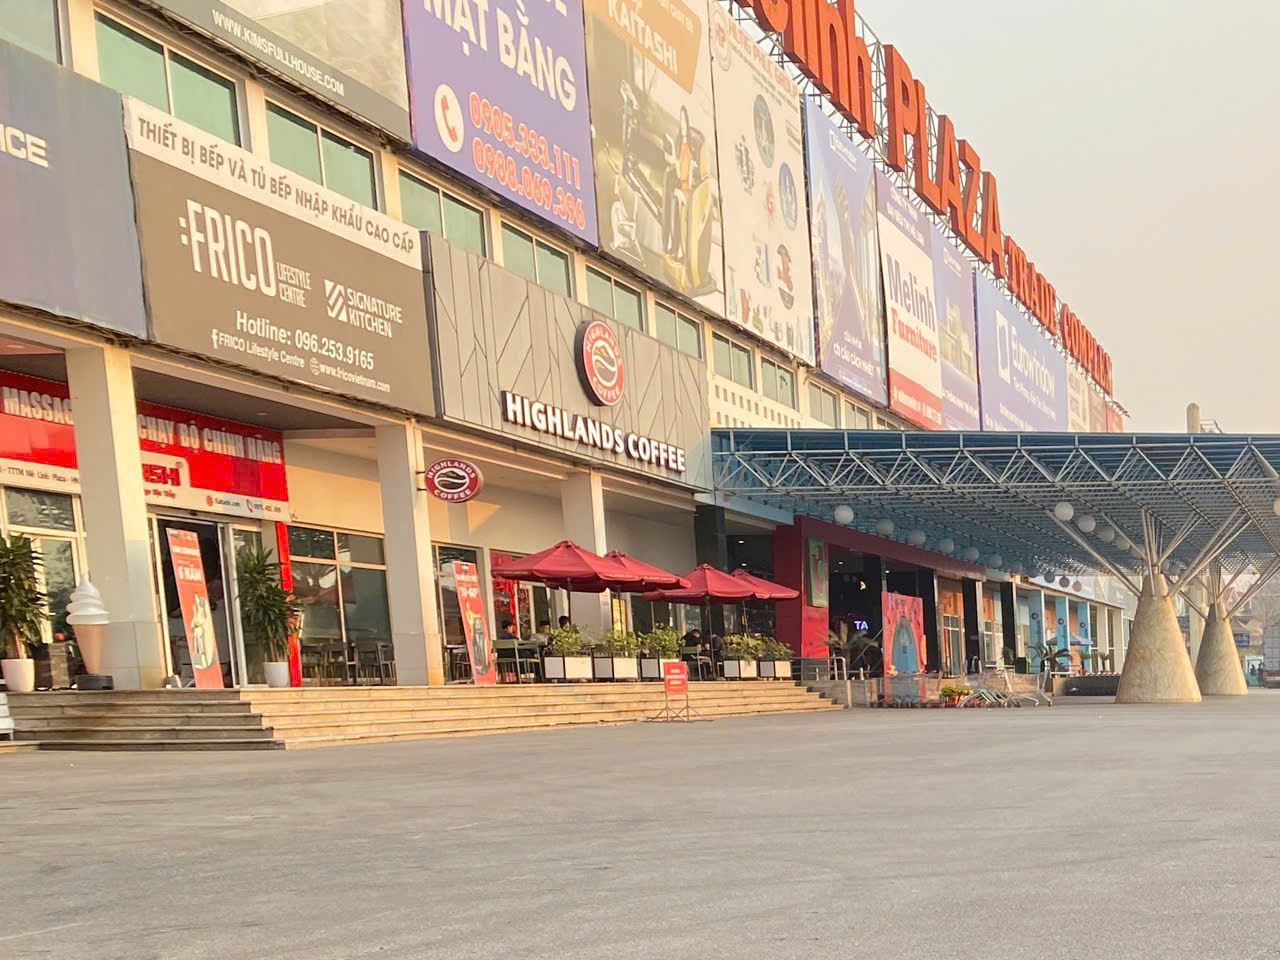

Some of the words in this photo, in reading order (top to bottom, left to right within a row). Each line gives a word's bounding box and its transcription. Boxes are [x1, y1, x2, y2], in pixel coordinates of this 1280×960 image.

[211, 9, 345, 96] WWW.KIMSFULLHOUSE.COM
[138, 117, 177, 150] THIẾT
[182, 136, 195, 164] BỊ
[200, 144, 224, 170] BẾP
[228, 157, 247, 183] VÀ
[251, 165, 266, 190] TỦ
[270, 175, 292, 200] BẾP
[296, 188, 328, 218] NHẬP
[332, 203, 362, 231] KHẨU
[366, 220, 390, 243] CAO
[393, 231, 414, 253] CẤP
[884, 44, 1006, 279] PLAZA
[1004, 235, 1057, 336] TRADE
[1059, 302, 1113, 397] COMPLEX
[276, 261, 312, 290] LIFESTYLE
[886, 253, 936, 333] Melinh
[278, 283, 306, 308] CENTRE
[346, 287, 403, 323] SIGNATURE
[236, 310, 292, 345] Hotline:
[294, 329, 374, 370] 096.253.9165
[348, 308, 393, 338] KITCHEN
[891, 306, 938, 362] Furniture
[218, 332, 245, 352] FRICO
[246, 341, 279, 361] Lifestyle
[280, 351, 305, 368] Centre
[319, 363, 391, 392] www.fricovietnam.com
[2, 386, 74, 425] MASSAG
[503, 391, 625, 455] HIGHLANDS
[626, 432, 687, 473] COFFEE
[426, 460, 477, 479] HIGHLANDS
[434, 488, 473, 500] COFFEE
